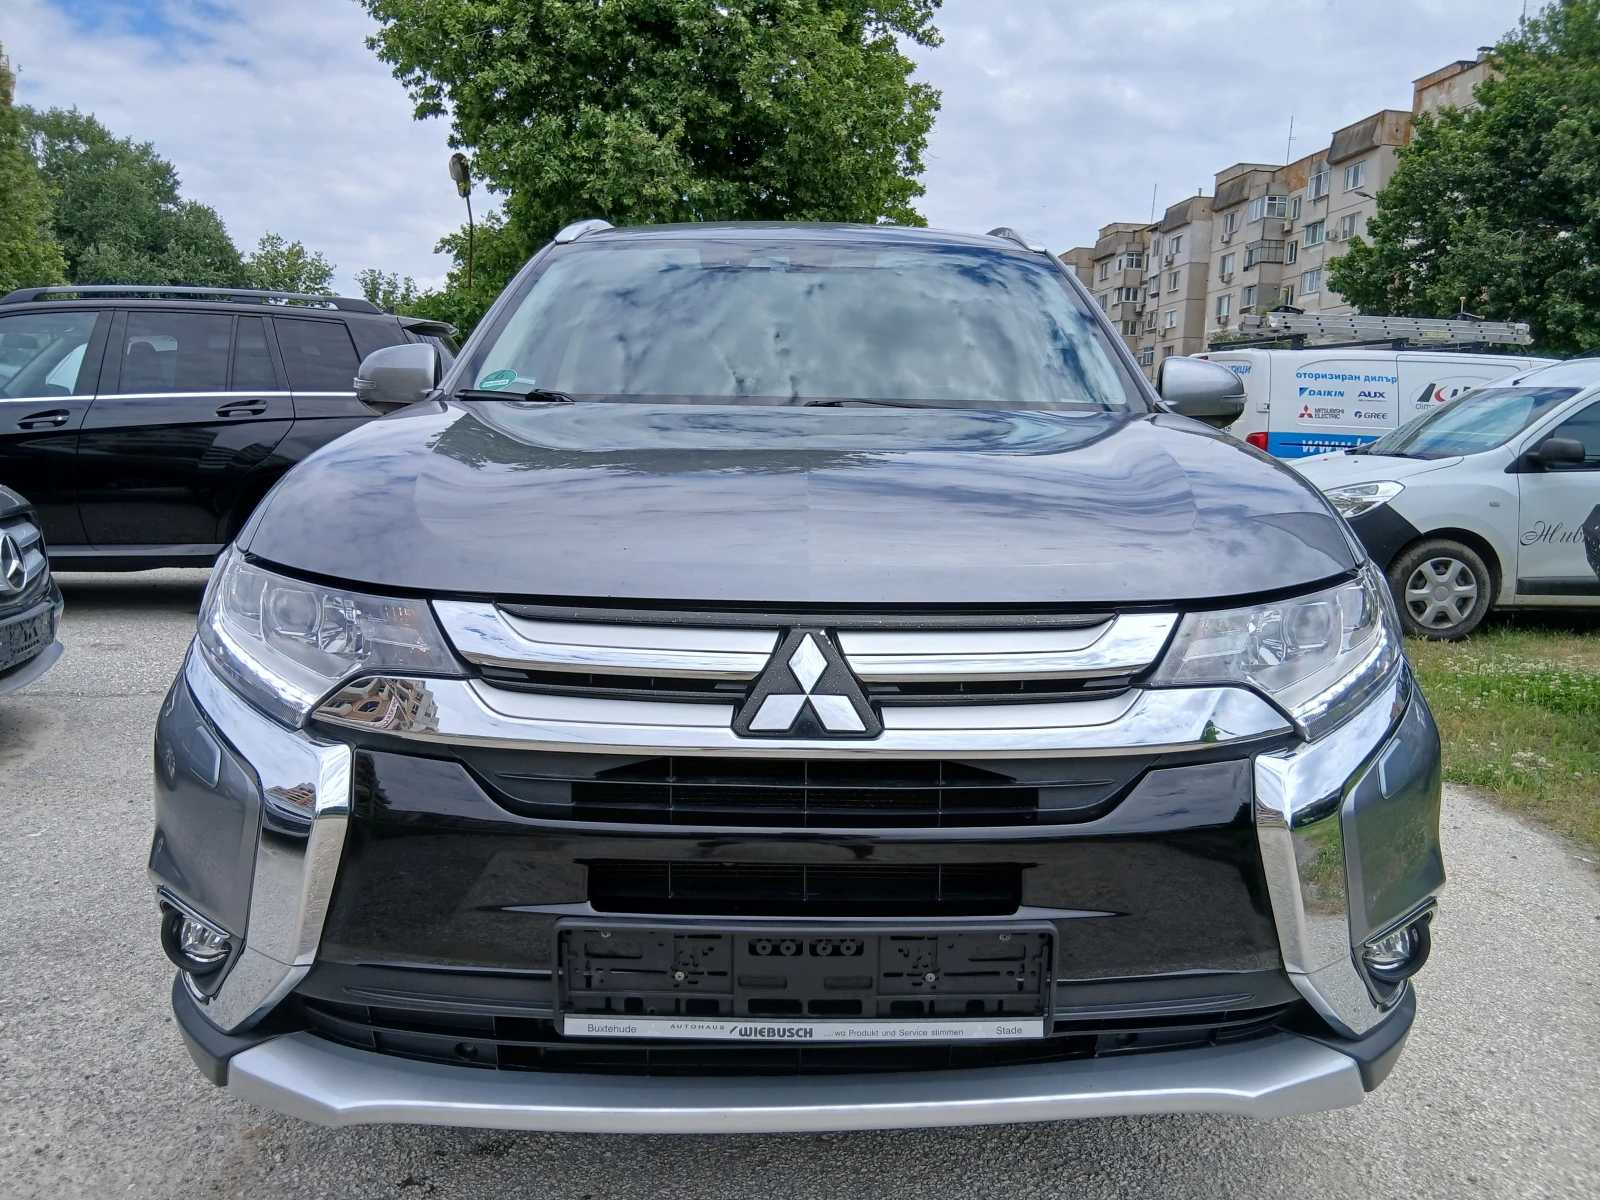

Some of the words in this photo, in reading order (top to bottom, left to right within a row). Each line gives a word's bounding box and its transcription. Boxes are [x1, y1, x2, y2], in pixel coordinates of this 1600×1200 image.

[1295, 371, 1361, 381] оторизиран
[1363, 375, 1398, 384] дилър
[1308, 389, 1345, 397] DAIKIN
[1357, 390, 1386, 399] AUX
[1364, 411, 1388, 419] GREE
[587, 1023, 637, 1033] Buxtehude
[738, 1026, 813, 1038] WIEBUSCH
[848, 1029, 879, 1037] Produkt
[881, 1029, 896, 1037] und
[899, 1029, 928, 1037] Service
[930, 1028, 964, 1036] stimmen
[996, 1026, 1023, 1035] Stade
